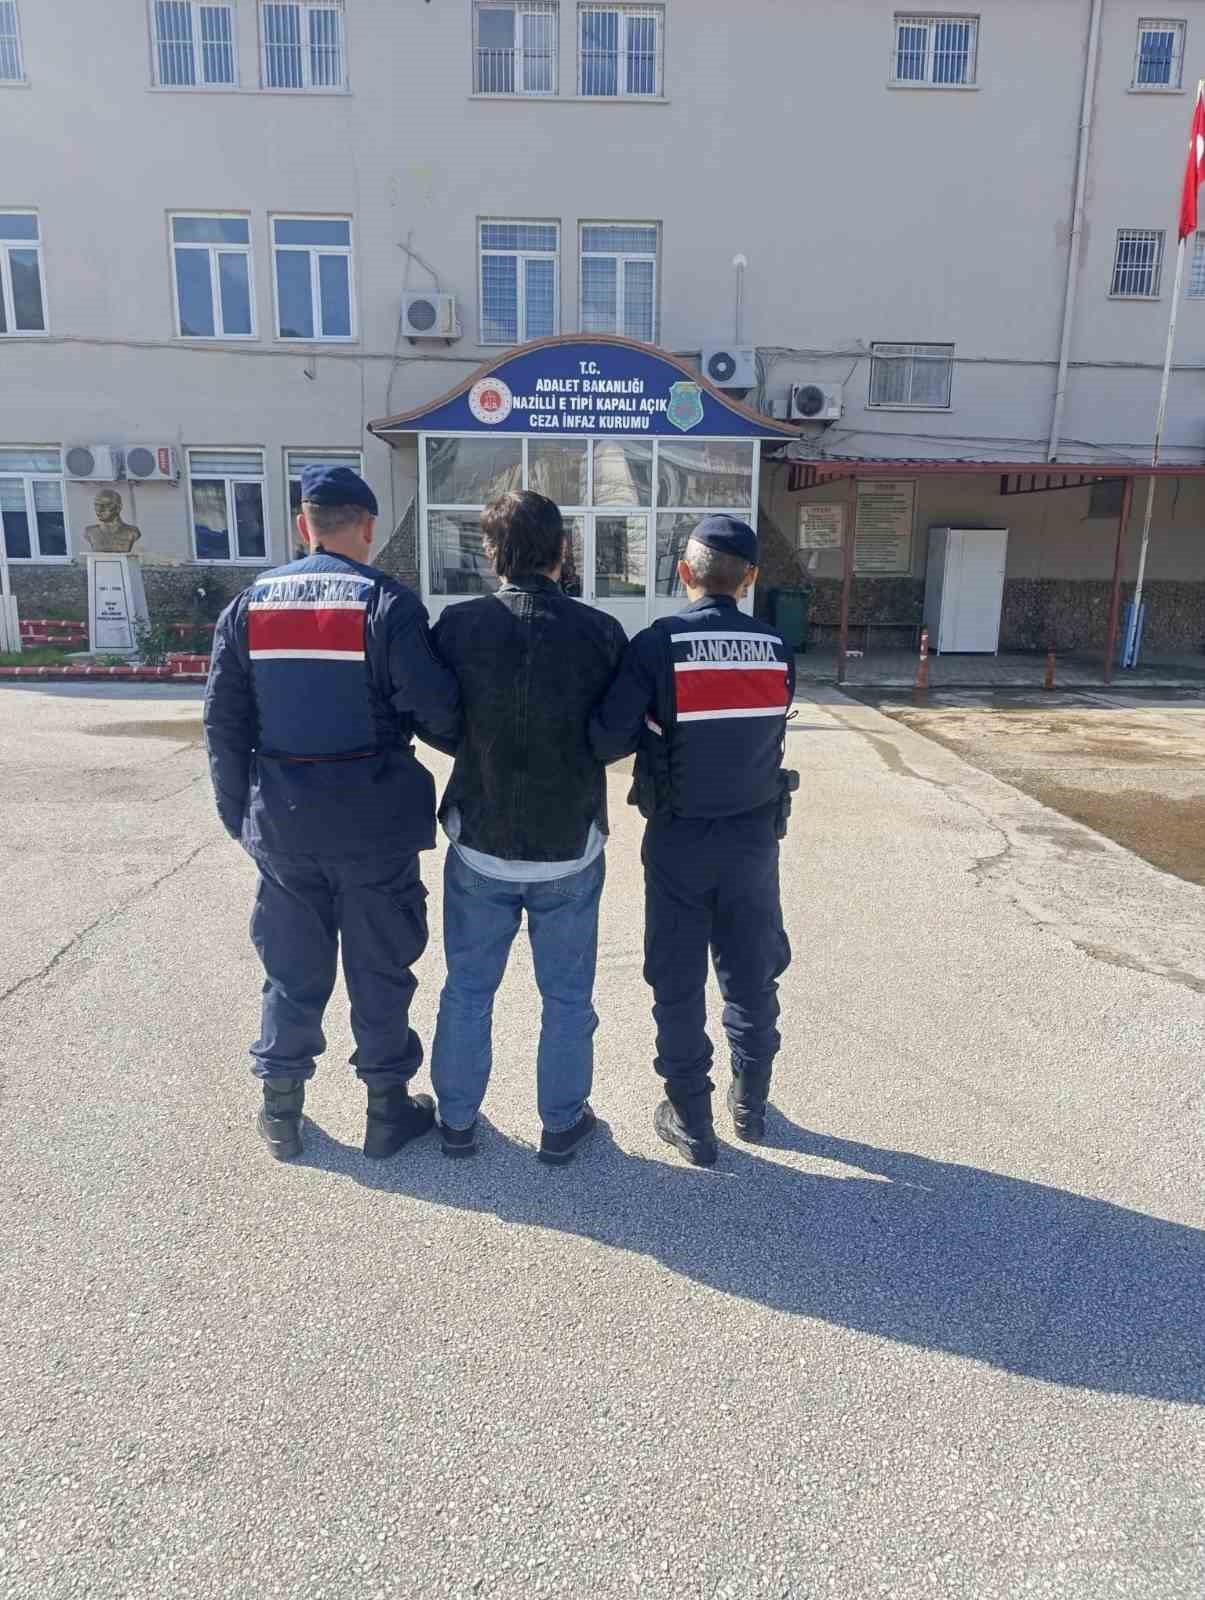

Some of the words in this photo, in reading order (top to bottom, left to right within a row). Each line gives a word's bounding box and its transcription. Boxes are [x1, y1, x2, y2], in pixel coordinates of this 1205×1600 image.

[579, 361, 601, 375] T.C.
[536, 379, 580, 392] ADALET
[583, 378, 644, 393] BAKANLIĞI
[513, 394, 556, 410] NAZİLLİ
[559, 397, 567, 411] E
[570, 394, 593, 411] TİPİ
[597, 398, 636, 411] KAPALI
[640, 399, 668, 415] AÇIK
[530, 414, 559, 428] CEZA
[563, 412, 595, 428] İNFAZ
[599, 415, 650, 429] KURUMU
[263, 579, 360, 601] JANDARMA
[686, 640, 777, 661] JANDARMA
